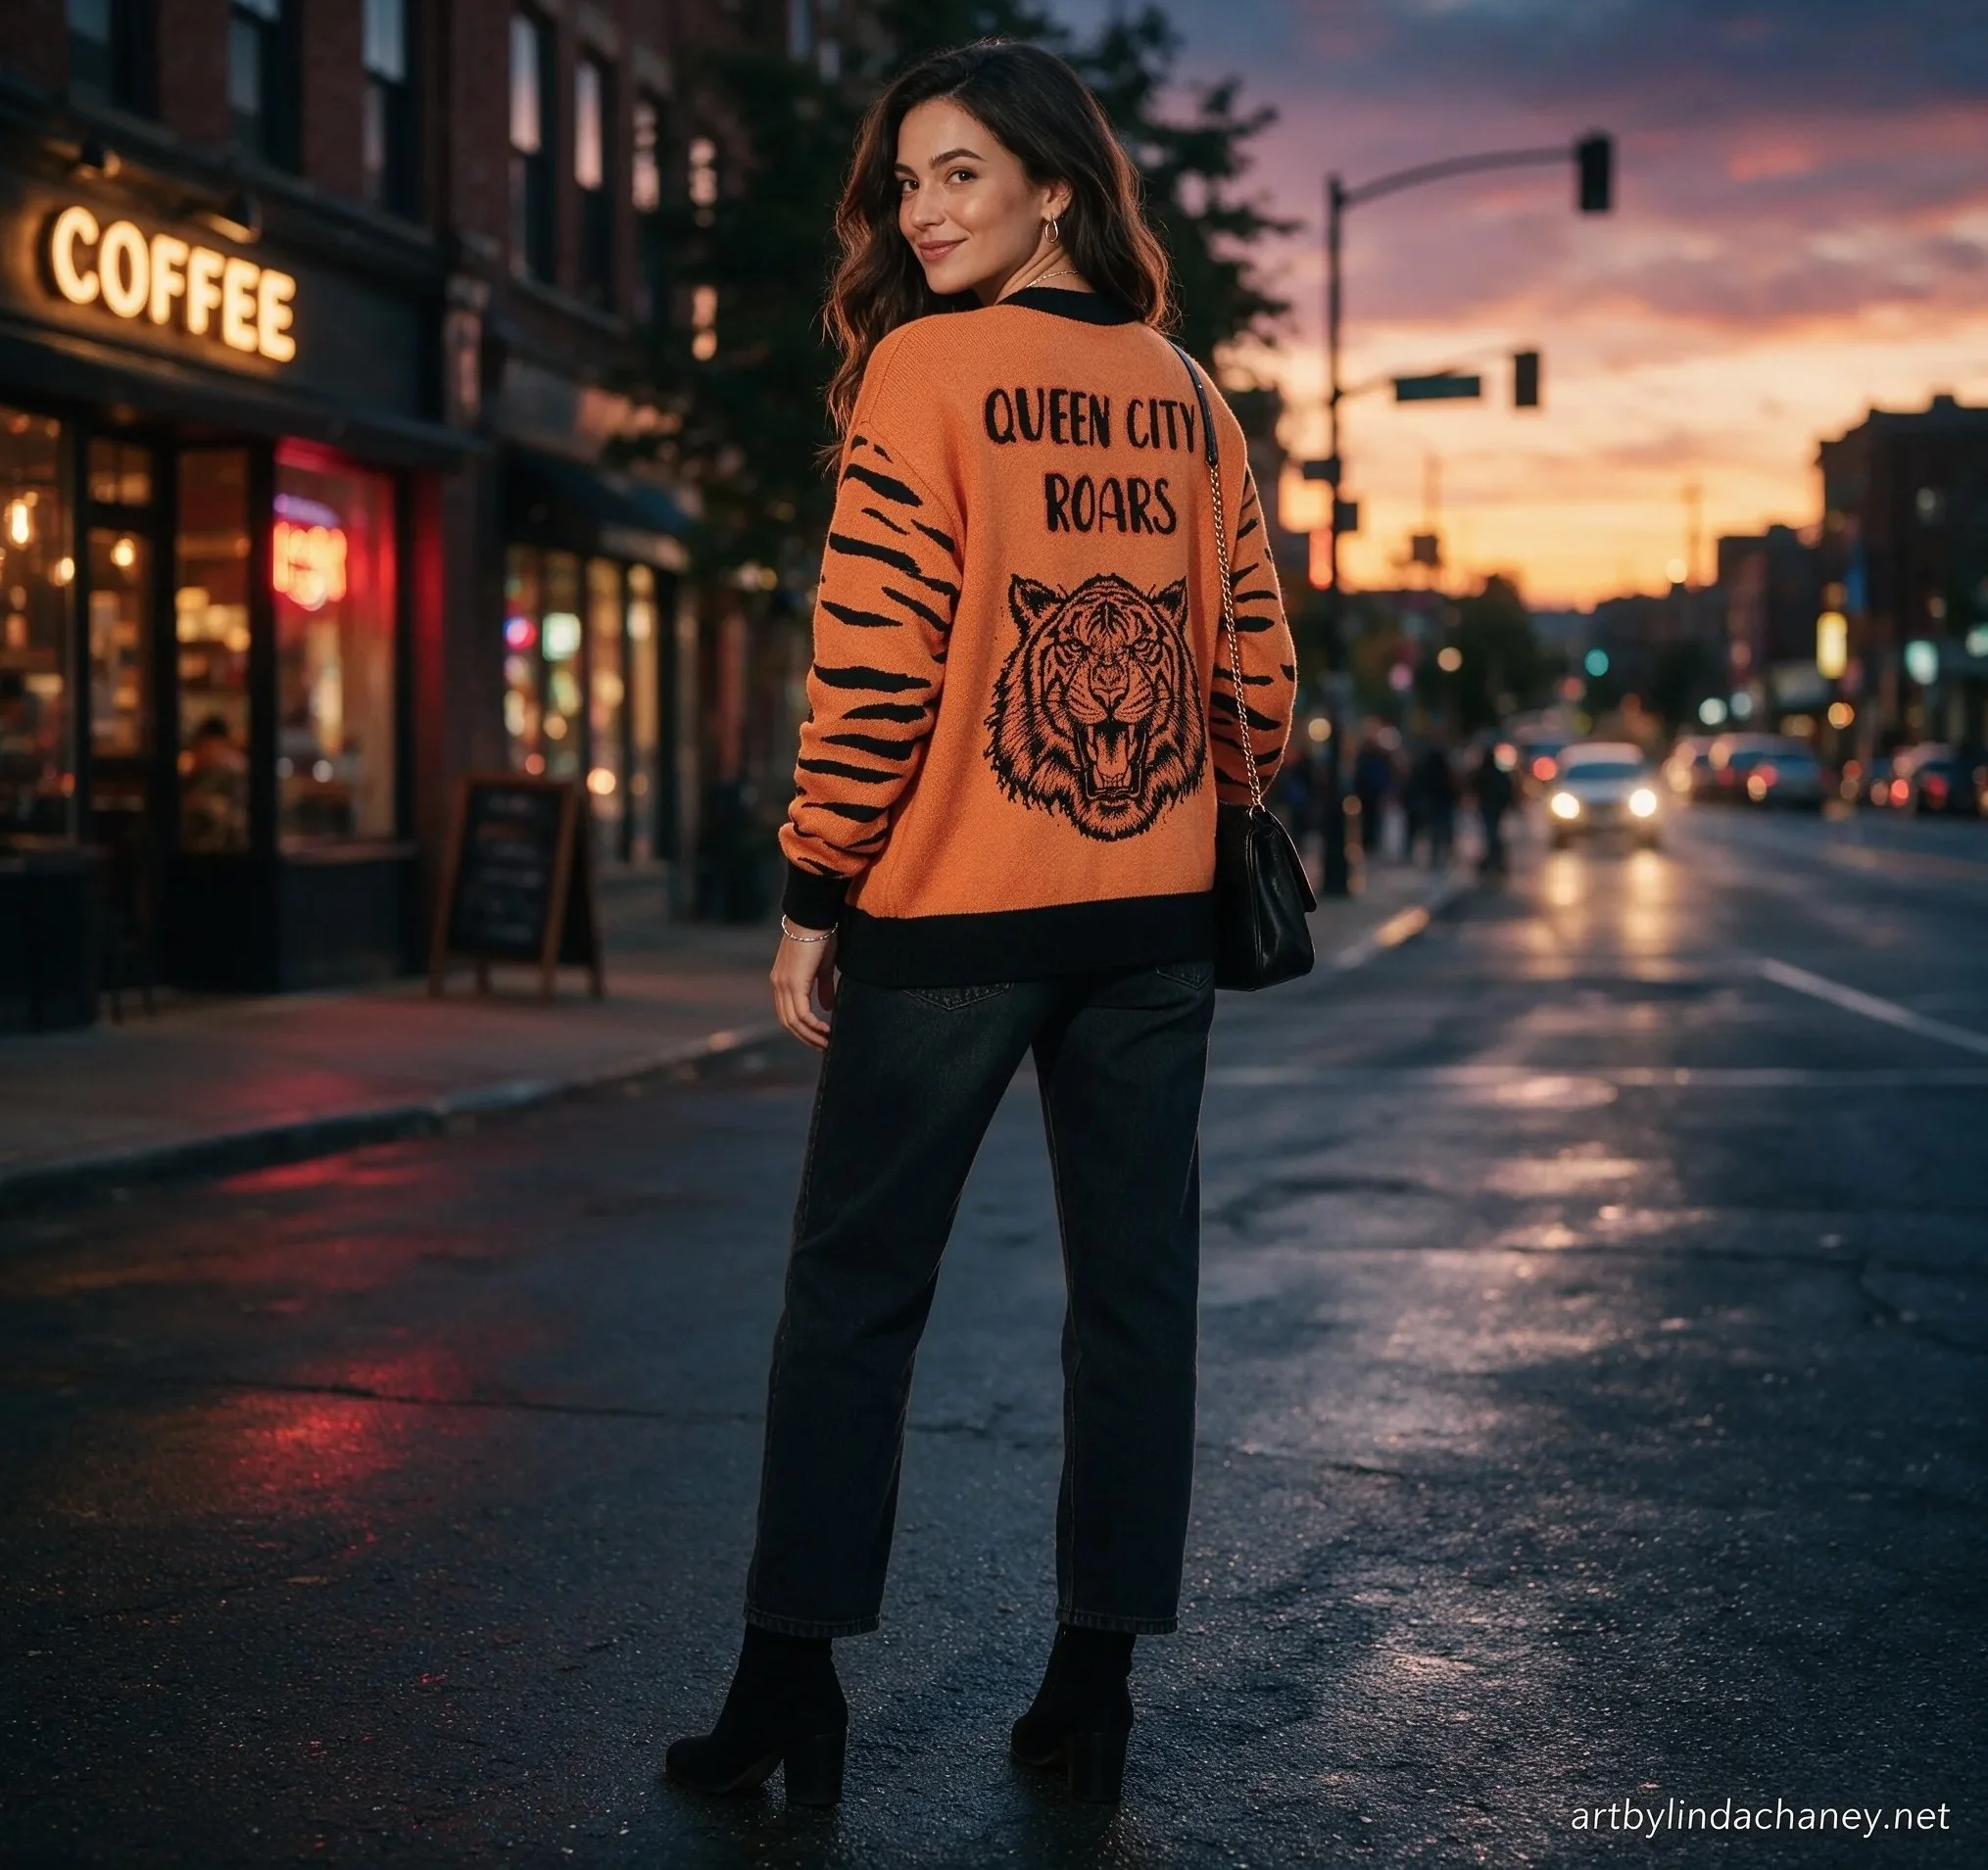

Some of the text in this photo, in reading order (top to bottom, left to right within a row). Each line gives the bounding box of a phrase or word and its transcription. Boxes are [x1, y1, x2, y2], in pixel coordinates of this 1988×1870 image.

[51, 206, 296, 362] COFFEE
[985, 387, 1195, 454] QUEEN CITY
[1044, 472, 1177, 535] ROARS
